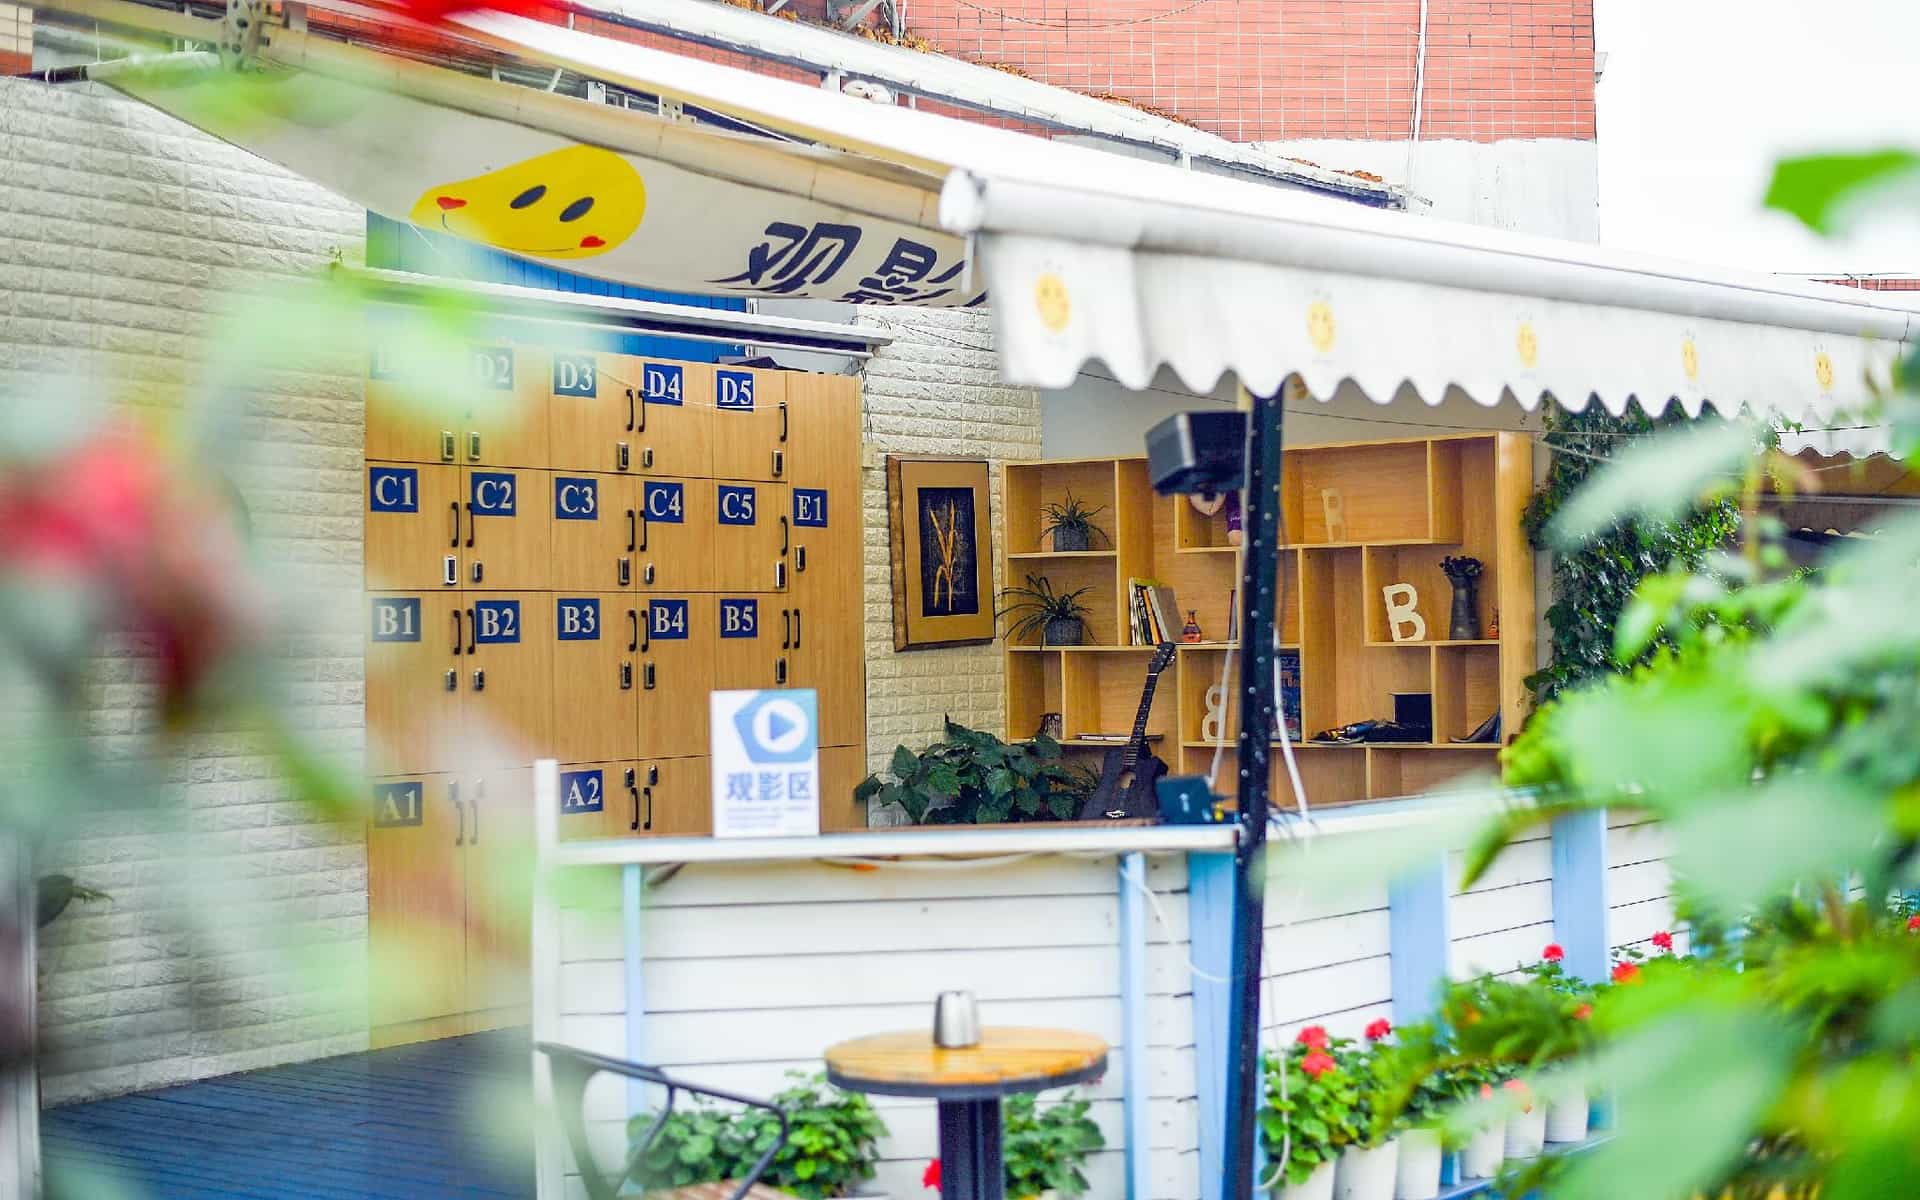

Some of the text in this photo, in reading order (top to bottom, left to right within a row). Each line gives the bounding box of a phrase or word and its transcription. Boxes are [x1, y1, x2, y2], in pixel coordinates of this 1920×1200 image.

[475, 354, 511, 384] D2
[560, 360, 593, 391] D3
[647, 371, 681, 401] D4
[720, 378, 752, 405] D5
[376, 475, 414, 506] C1
[476, 480, 513, 510] C2
[560, 484, 595, 514] C3
[649, 488, 682, 517] C4
[722, 492, 753, 520] C5
[796, 494, 823, 521] E1
[376, 605, 415, 636] B1
[479, 607, 516, 637] B2
[562, 605, 596, 633] B3
[653, 606, 684, 633] B4
[724, 605, 754, 632] B5
[1383, 583, 1426, 642] B
[565, 777, 600, 808] A2
[727, 771, 812, 801] 观影区
[381, 789, 417, 821] A1
